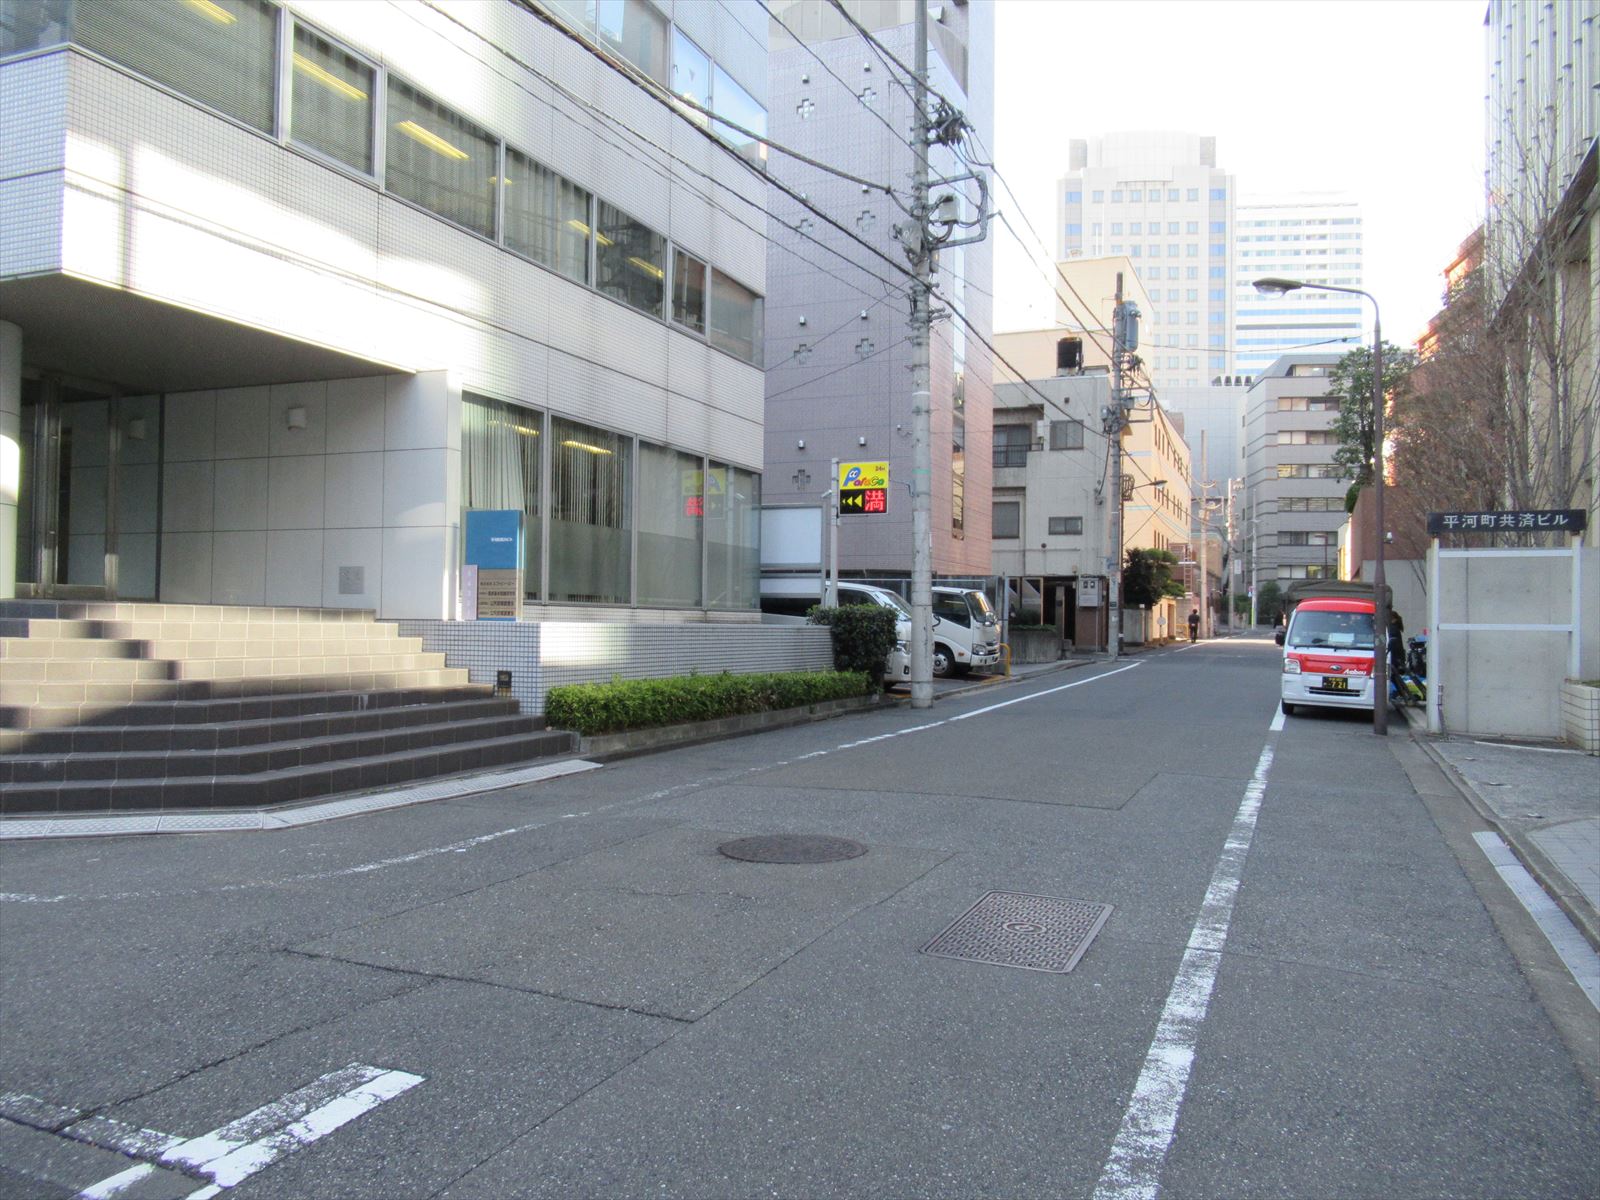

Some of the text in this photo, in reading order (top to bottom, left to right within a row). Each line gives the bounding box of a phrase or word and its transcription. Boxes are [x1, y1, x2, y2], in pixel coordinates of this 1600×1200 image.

[865, 490, 885, 510] 満
[1443, 513, 1568, 528] 平河町共済ビル
